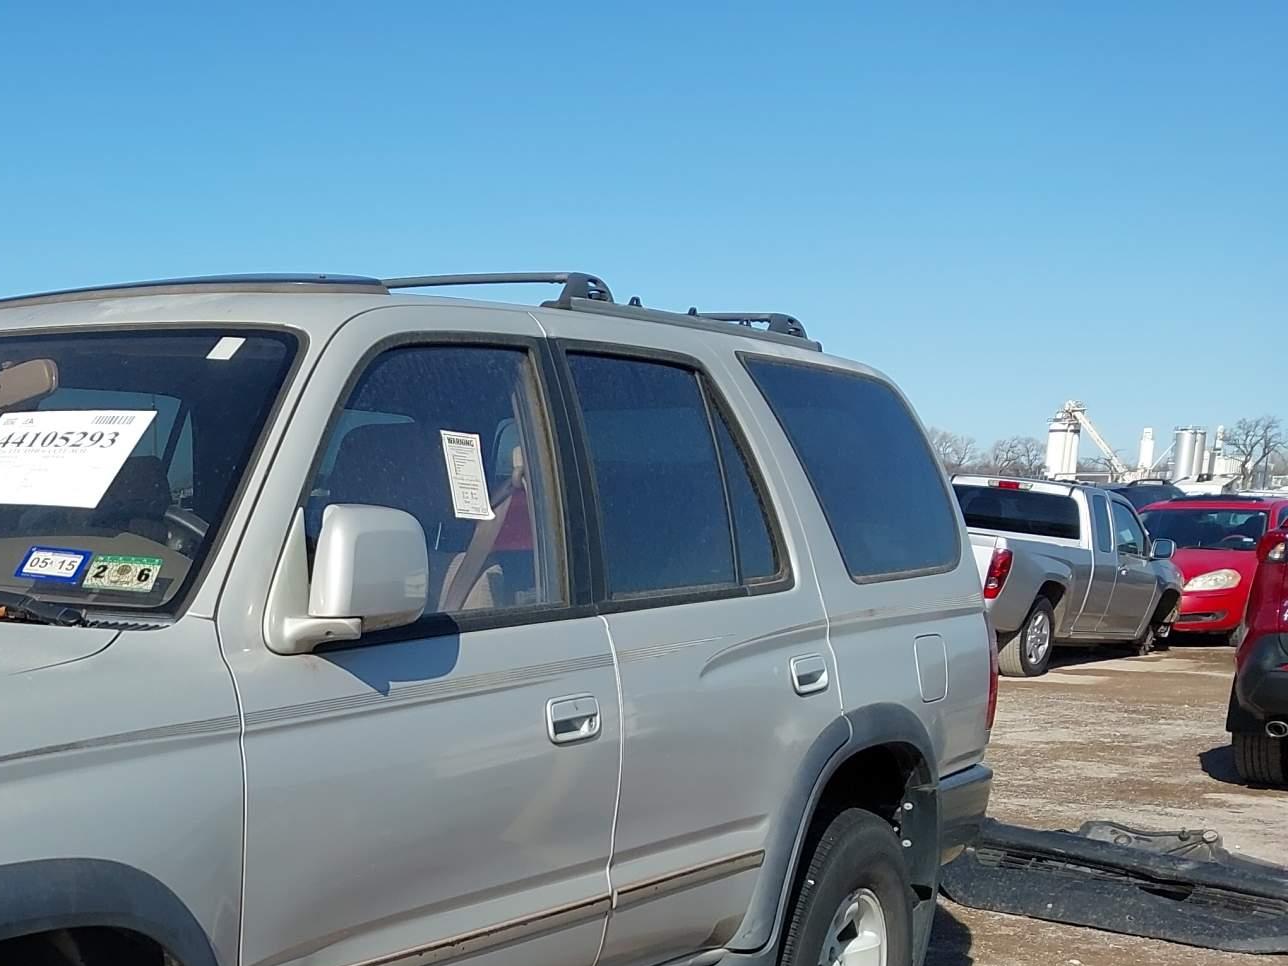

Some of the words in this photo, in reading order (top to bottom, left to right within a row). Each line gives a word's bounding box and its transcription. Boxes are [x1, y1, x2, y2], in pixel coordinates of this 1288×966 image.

[57, 559, 78, 571] 15
[92, 564, 109, 579] 2
[137, 567, 152, 583] 6
